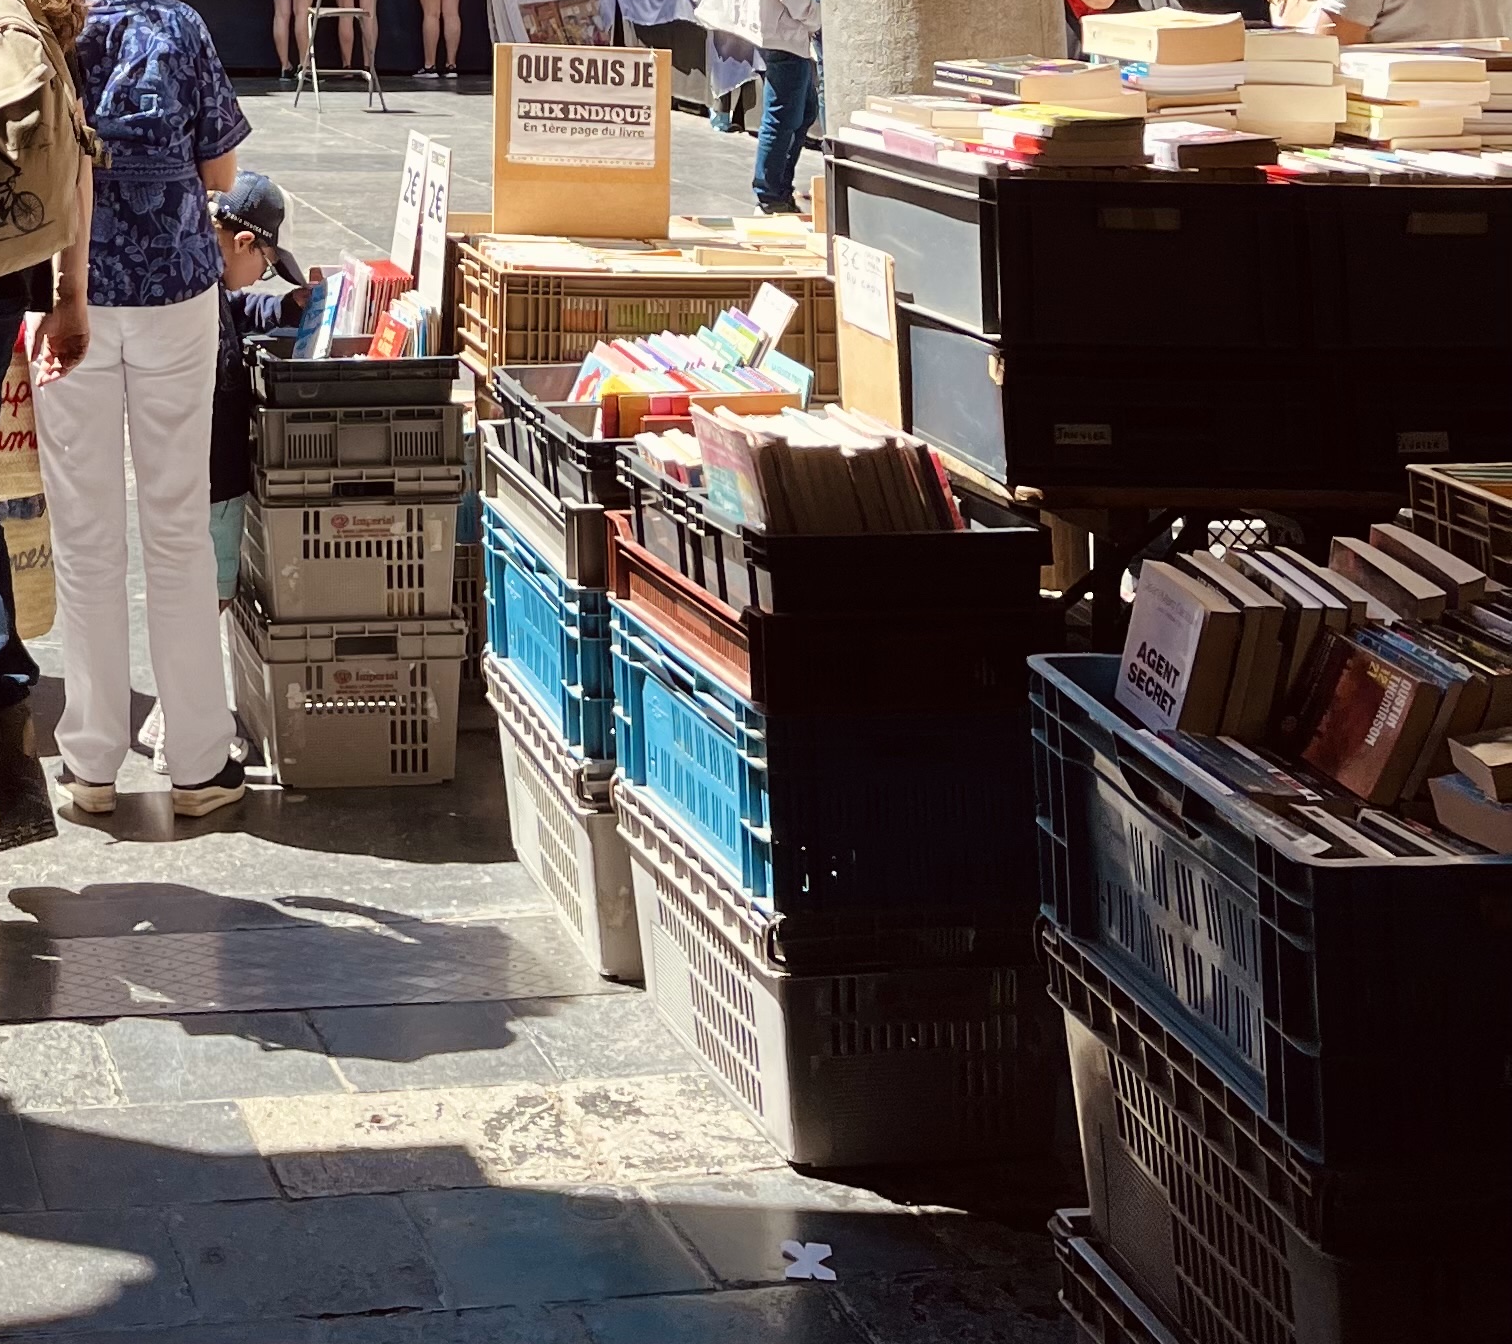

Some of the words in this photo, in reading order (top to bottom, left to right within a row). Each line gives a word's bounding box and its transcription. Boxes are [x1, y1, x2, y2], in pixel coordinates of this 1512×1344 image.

[517, 54, 563, 84] QUE
[569, 56, 625, 86] SAIS
[630, 61, 654, 88] JE
[518, 101, 565, 119] PRIX
[567, 105, 651, 124] INDIQUÉ
[523, 122, 538, 133] En
[541, 123, 567, 134] 1ère
[570, 126, 599, 137] page
[601, 126, 616, 137] du
[619, 126, 645, 138] livre
[403, 166, 421, 207] 2€
[428, 180, 445, 223] 2€
[352, 515, 395, 527] Imperial
[1136, 641, 1180, 689] AGENT
[1127, 662, 1177, 718] SECRET
[1364, 675, 1401, 747] THOMASON
[1385, 678, 1412, 729] DUSTIN
